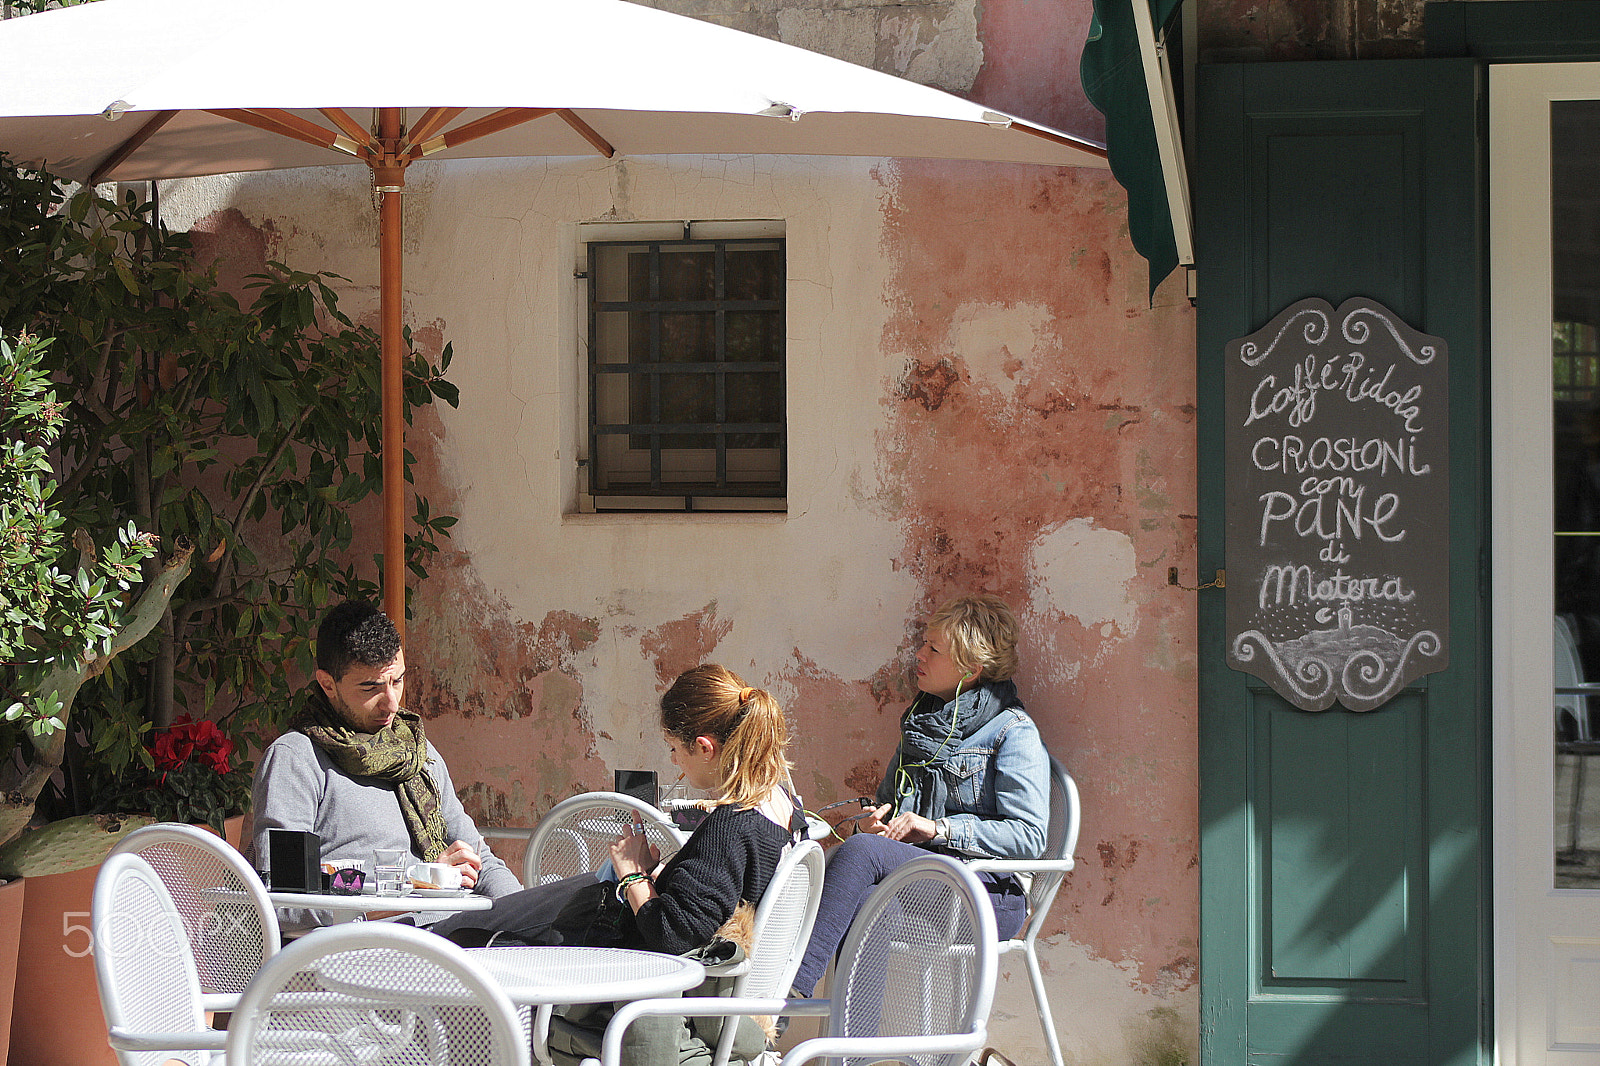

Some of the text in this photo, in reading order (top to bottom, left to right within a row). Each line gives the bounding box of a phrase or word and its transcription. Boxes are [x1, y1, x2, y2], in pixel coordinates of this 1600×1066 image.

[1339, 351, 1424, 433] Ridola
[1300, 476, 1354, 497] con
[1319, 540, 1351, 563] di
[1258, 564, 1416, 610] Matera
